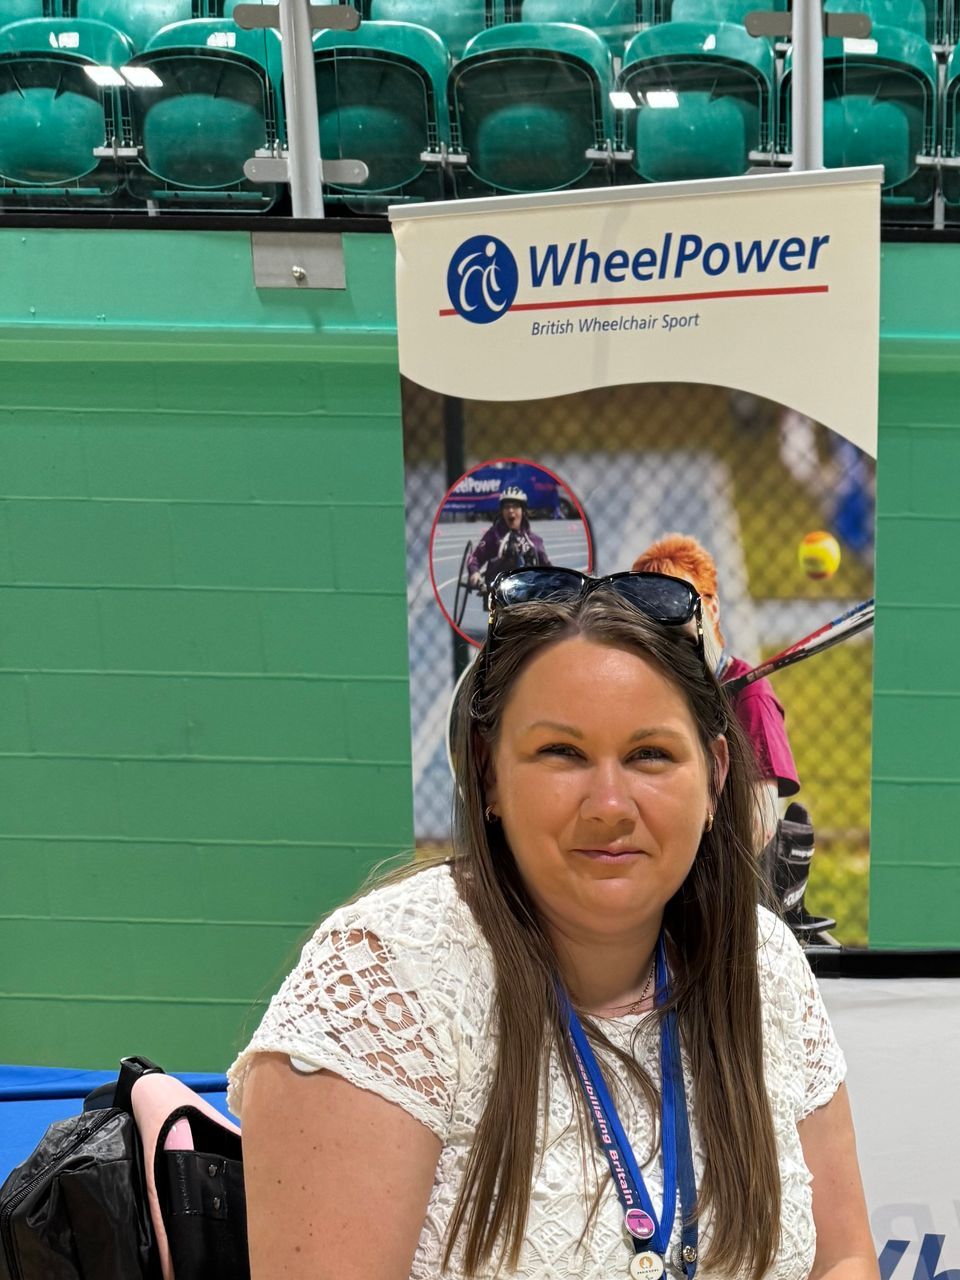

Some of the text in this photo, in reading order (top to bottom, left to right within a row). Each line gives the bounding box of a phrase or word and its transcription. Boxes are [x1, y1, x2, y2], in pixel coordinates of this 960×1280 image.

[529, 232, 830, 288] WheelPower
[531, 312, 701, 336] British Wheelchair Sport
[608, 1149, 634, 1206] Britain
